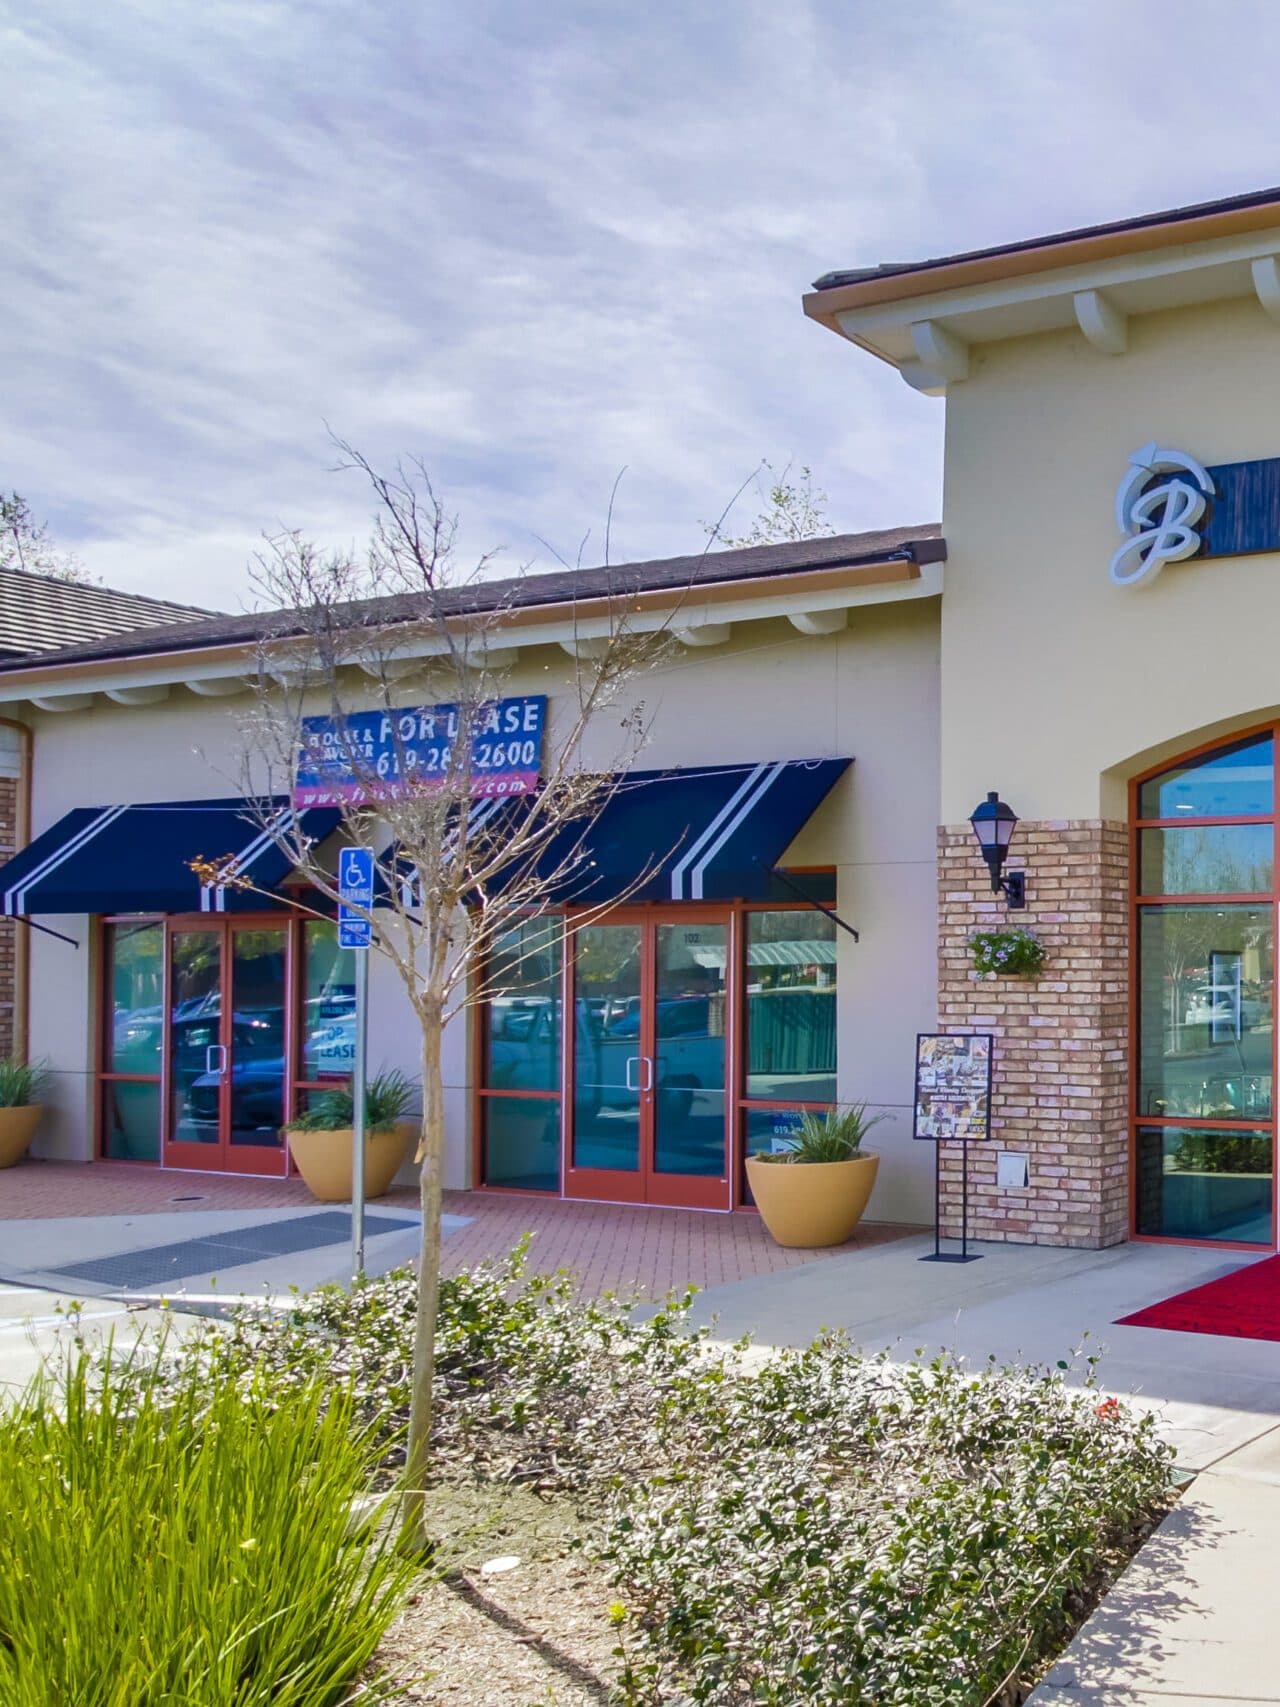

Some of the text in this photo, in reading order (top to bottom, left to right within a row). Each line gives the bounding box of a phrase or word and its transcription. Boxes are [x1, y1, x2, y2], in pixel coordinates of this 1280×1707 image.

[379, 703, 540, 744] FOR LASE
[376, 740, 535, 776] 619-28-2600
